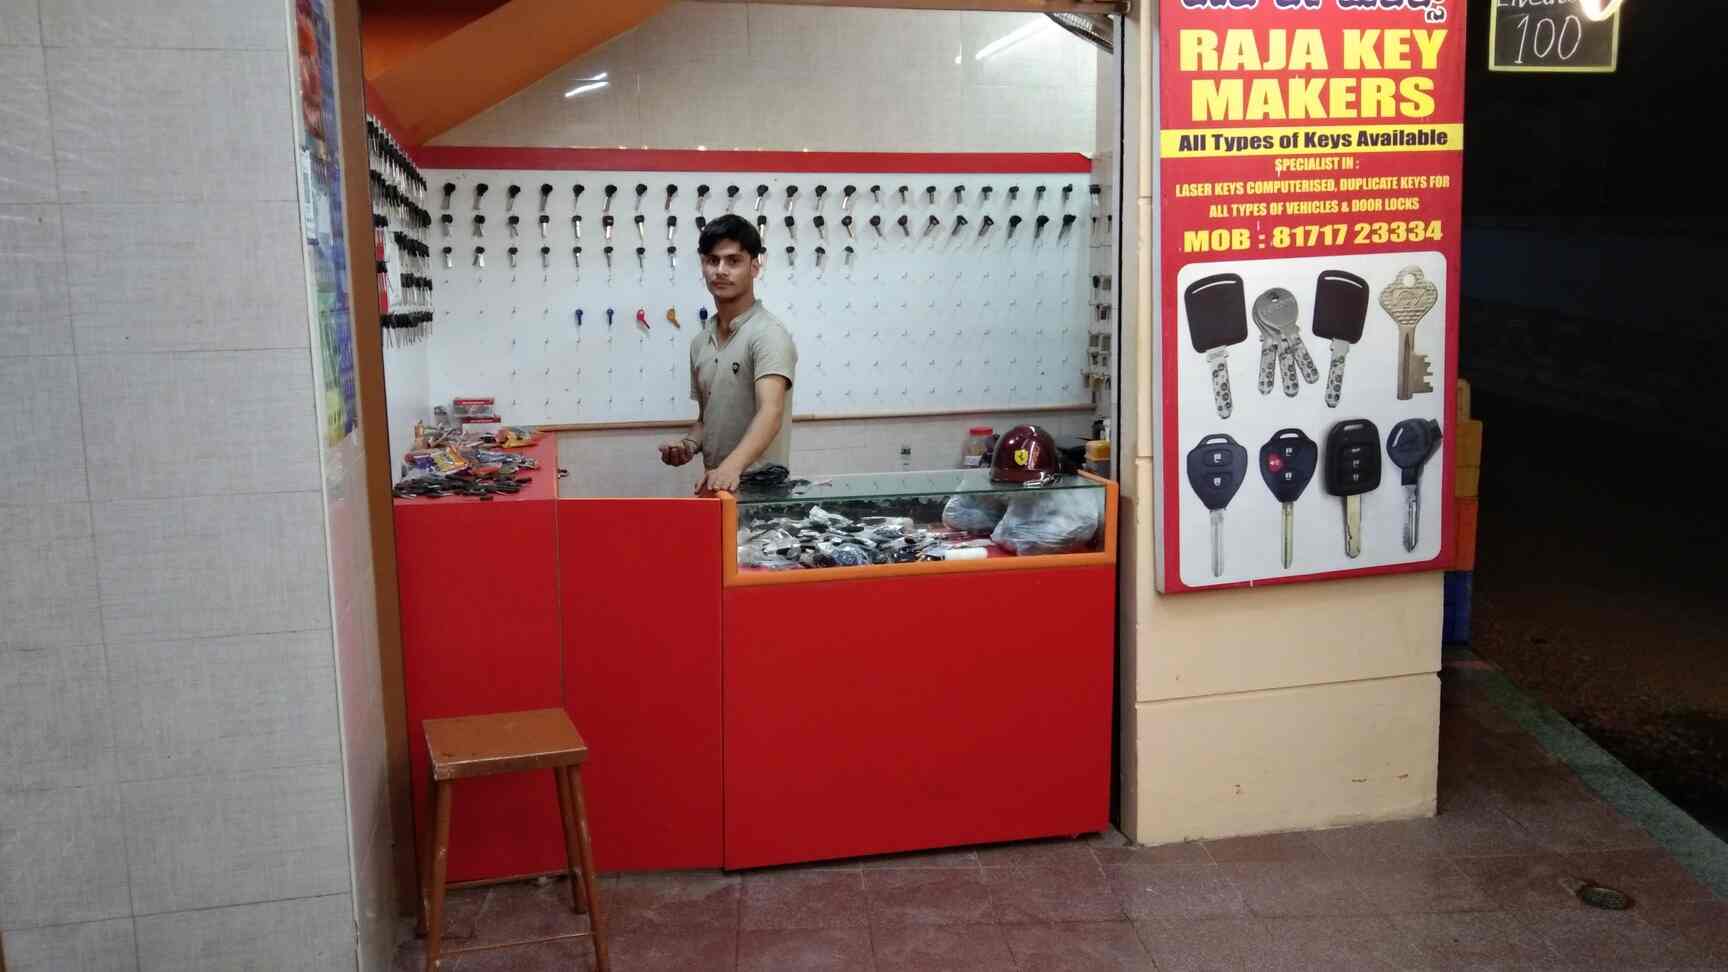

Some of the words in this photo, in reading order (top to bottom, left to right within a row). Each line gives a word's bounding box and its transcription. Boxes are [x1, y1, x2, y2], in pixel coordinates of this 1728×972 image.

[1179, 28, 1328, 71] RAJA
[1343, 28, 1448, 70] KEY
[1514, 15, 1582, 63] 100
[1191, 76, 1435, 121] MAKERS
[1179, 134, 1206, 151] All
[1211, 133, 1274, 152] Types
[1279, 132, 1299, 149] of
[1304, 131, 1352, 149] Keys
[1357, 129, 1448, 147] Available
[1274, 157, 1340, 171] SPECIALIST
[1342, 156, 1354, 170] IN
[1175, 183, 1212, 198] LASER
[1214, 182, 1244, 196] KEYS
[1246, 179, 1338, 195] COMPUTERISED,
[1340, 176, 1398, 191] DUPLICATE
[1400, 175, 1427, 189] KEYS
[1429, 175, 1450, 188] FOR
[1209, 204, 1229, 218] ALL
[1231, 202, 1267, 217] TYPES
[1269, 201, 1284, 216] OF
[1285, 200, 1339, 215] VEHICLES
[1341, 201, 1349, 213] &
[1351, 198, 1382, 213] DOOR
[1384, 197, 1420, 211] LOCKS
[1183, 228, 1250, 253] MOB
[1271, 223, 1348, 249] 81717
[1353, 220, 1444, 245] 23334
